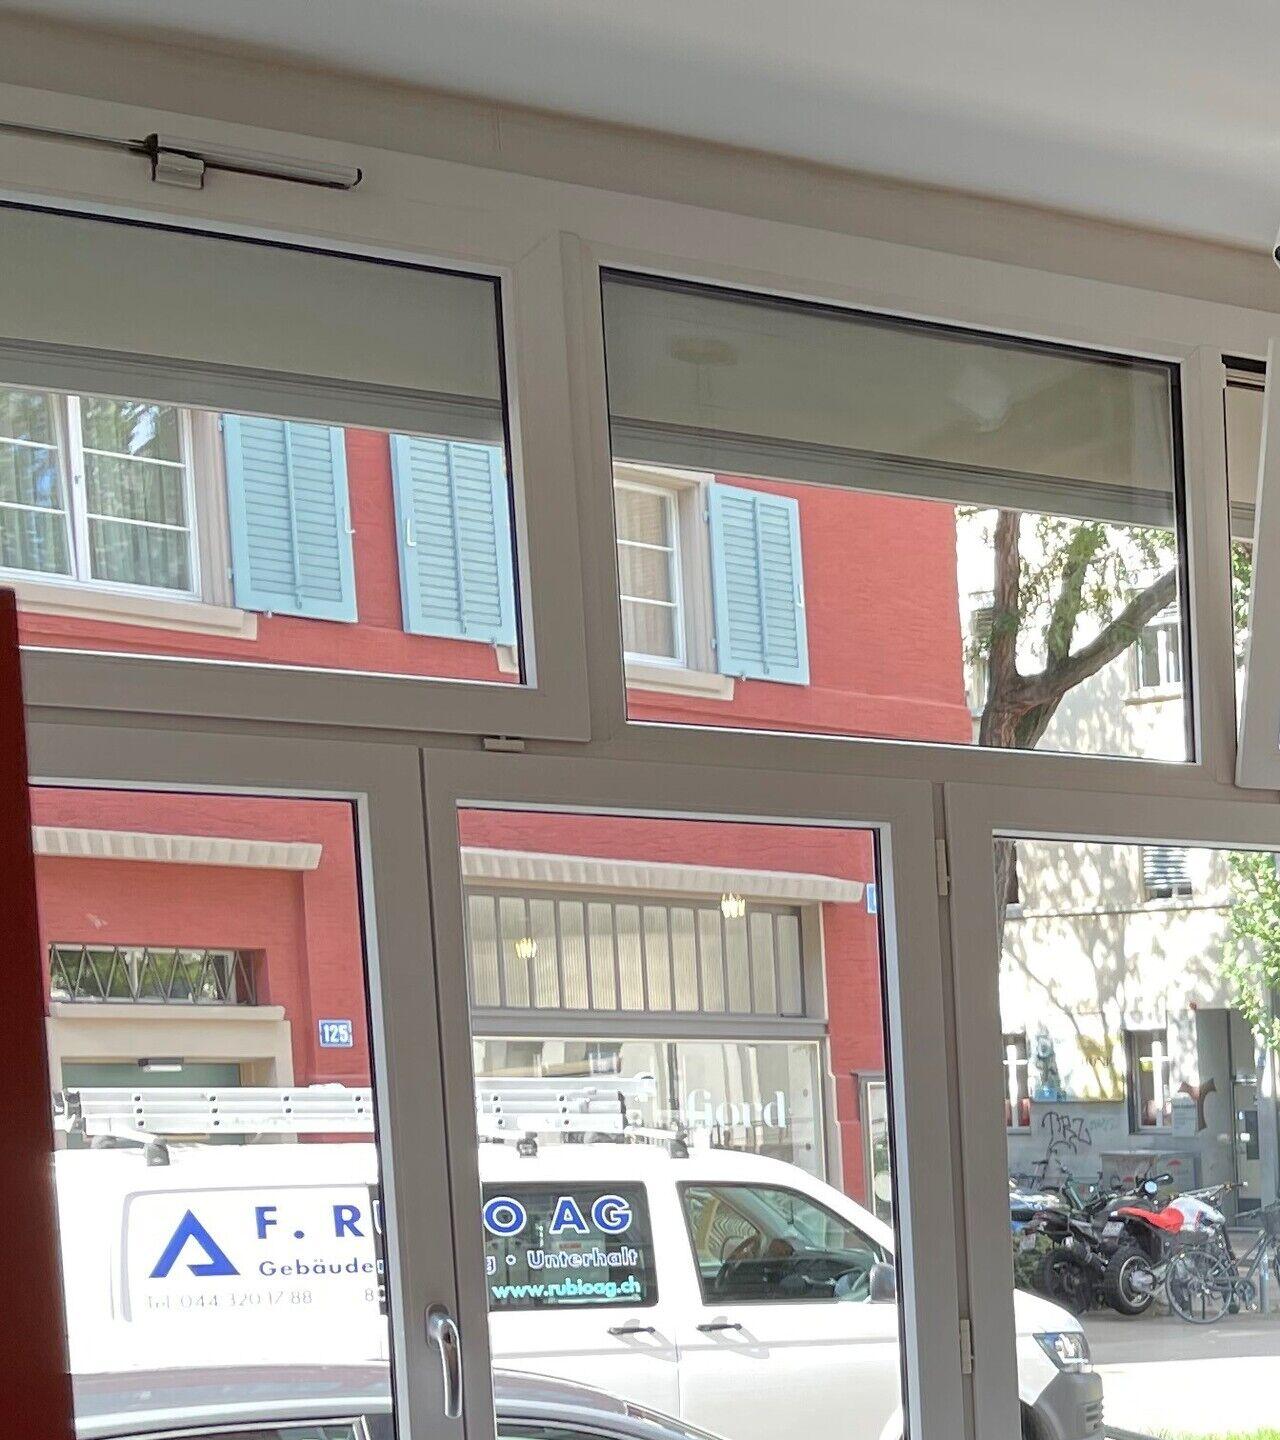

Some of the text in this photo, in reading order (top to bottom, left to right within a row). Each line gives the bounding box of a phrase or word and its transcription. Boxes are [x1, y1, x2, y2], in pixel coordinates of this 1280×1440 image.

[322, 1023, 350, 1044] 125
[548, 1193, 633, 1236] AG
[526, 1245, 638, 1270] Unterhalt
[491, 1274, 642, 1300] www.rubioag.ch
